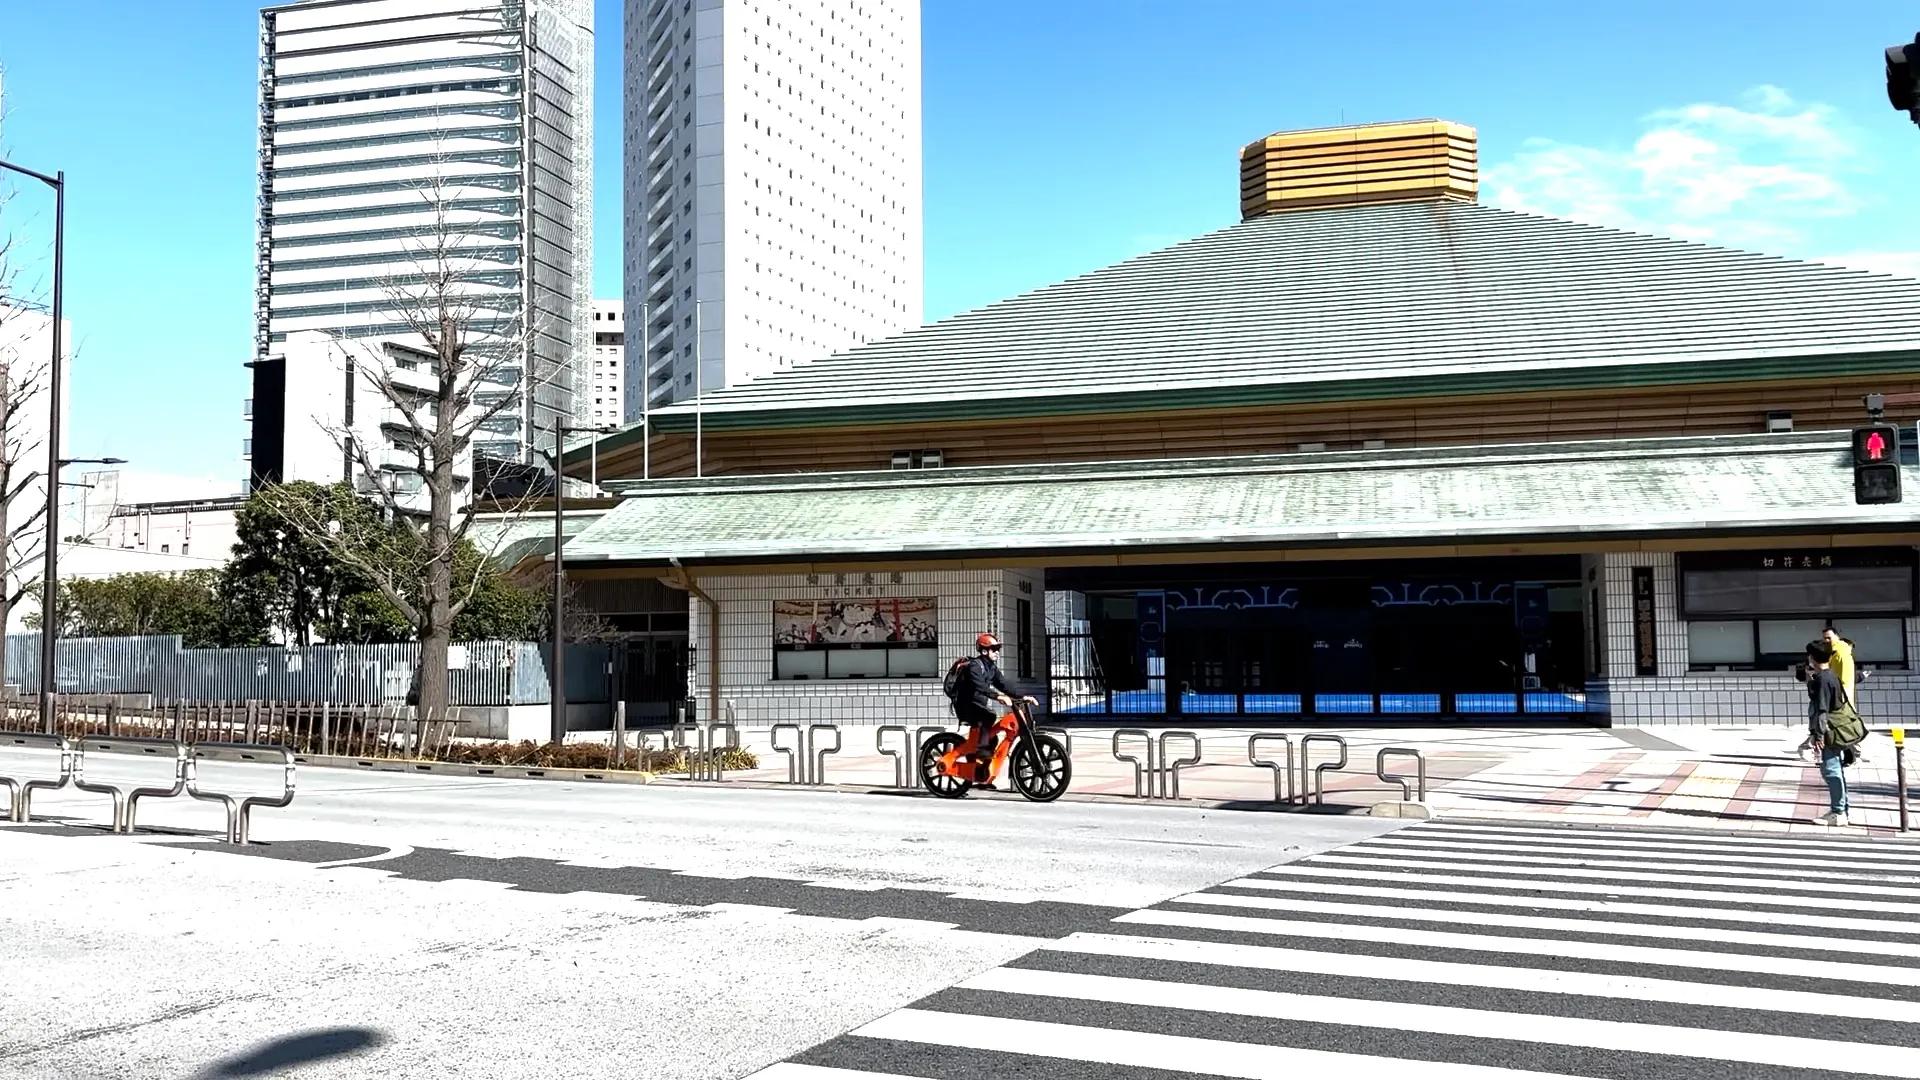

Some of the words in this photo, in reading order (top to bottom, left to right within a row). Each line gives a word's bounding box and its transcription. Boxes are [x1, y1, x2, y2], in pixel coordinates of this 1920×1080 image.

[1762, 555, 1832, 568] 切符売場
[824, 587, 885, 596] TICKET
